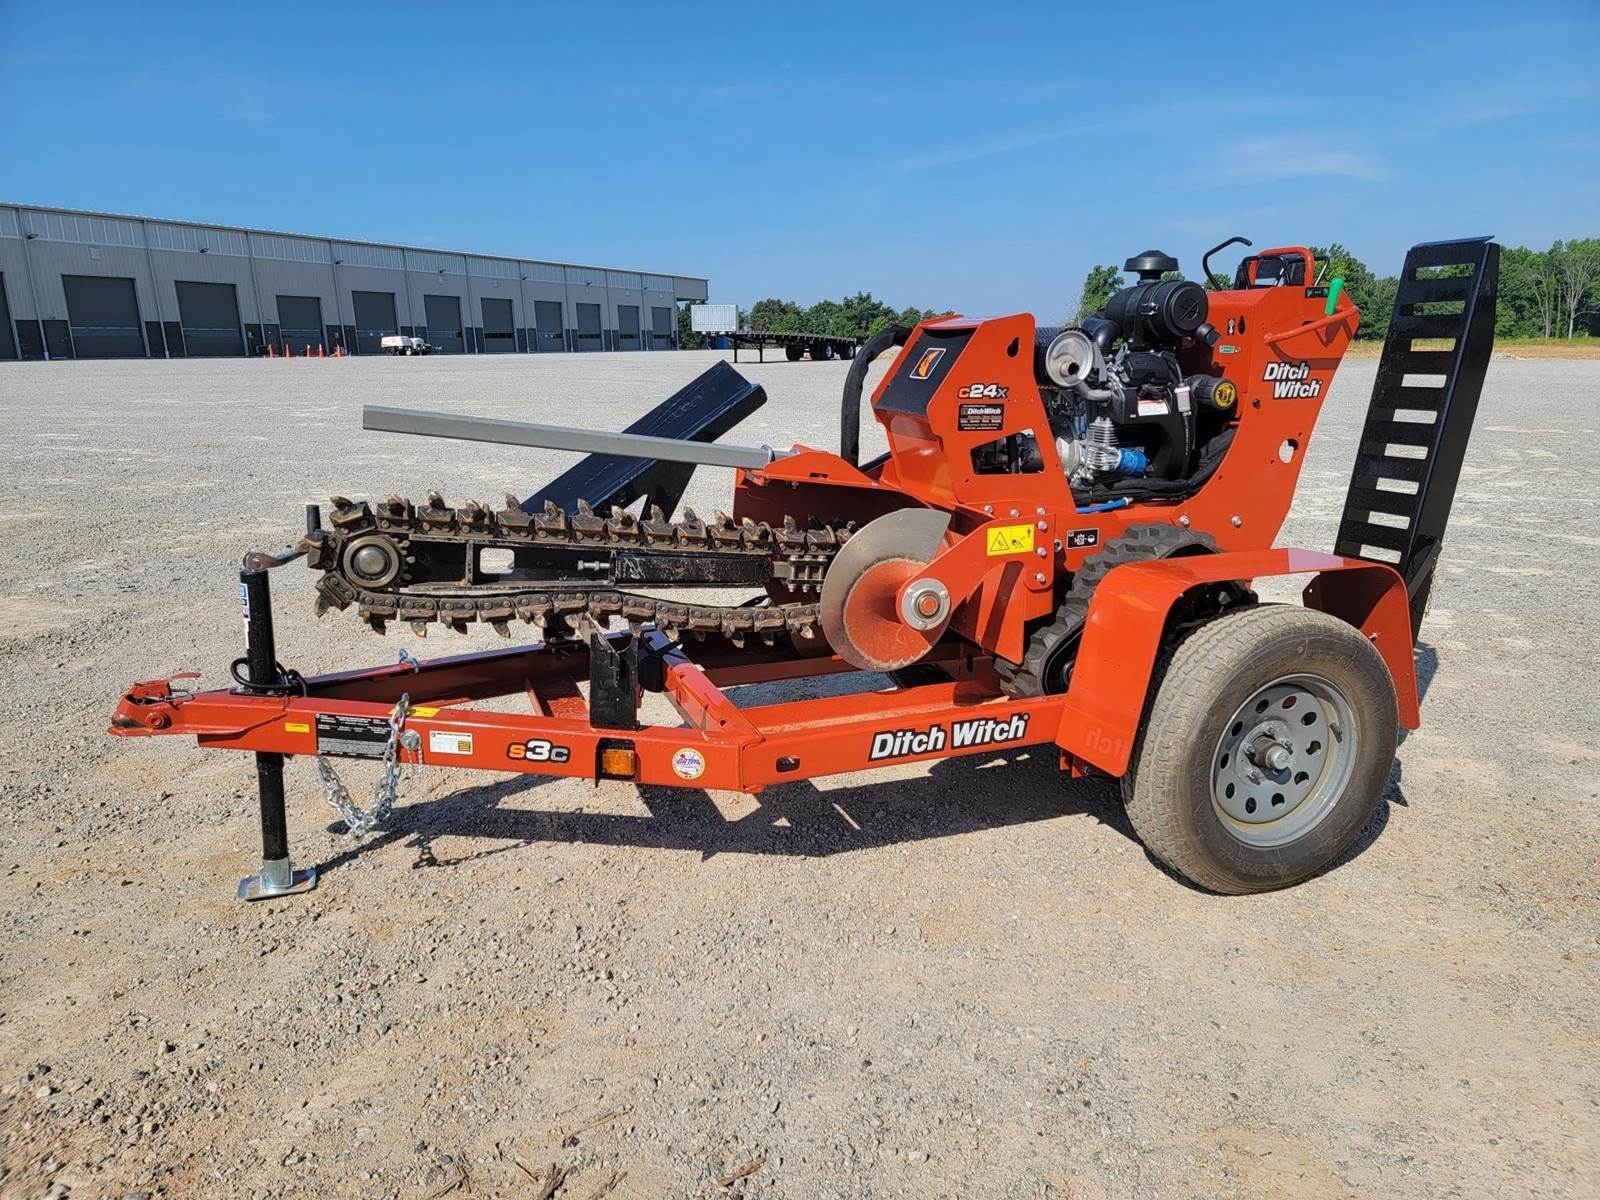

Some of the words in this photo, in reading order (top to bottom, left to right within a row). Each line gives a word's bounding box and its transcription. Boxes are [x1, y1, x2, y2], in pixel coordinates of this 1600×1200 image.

[1263, 361, 1309, 380] Ditch
[1273, 380, 1321, 399] Witch
[870, 725, 945, 760] Ditch
[952, 713, 1028, 748] Witch
